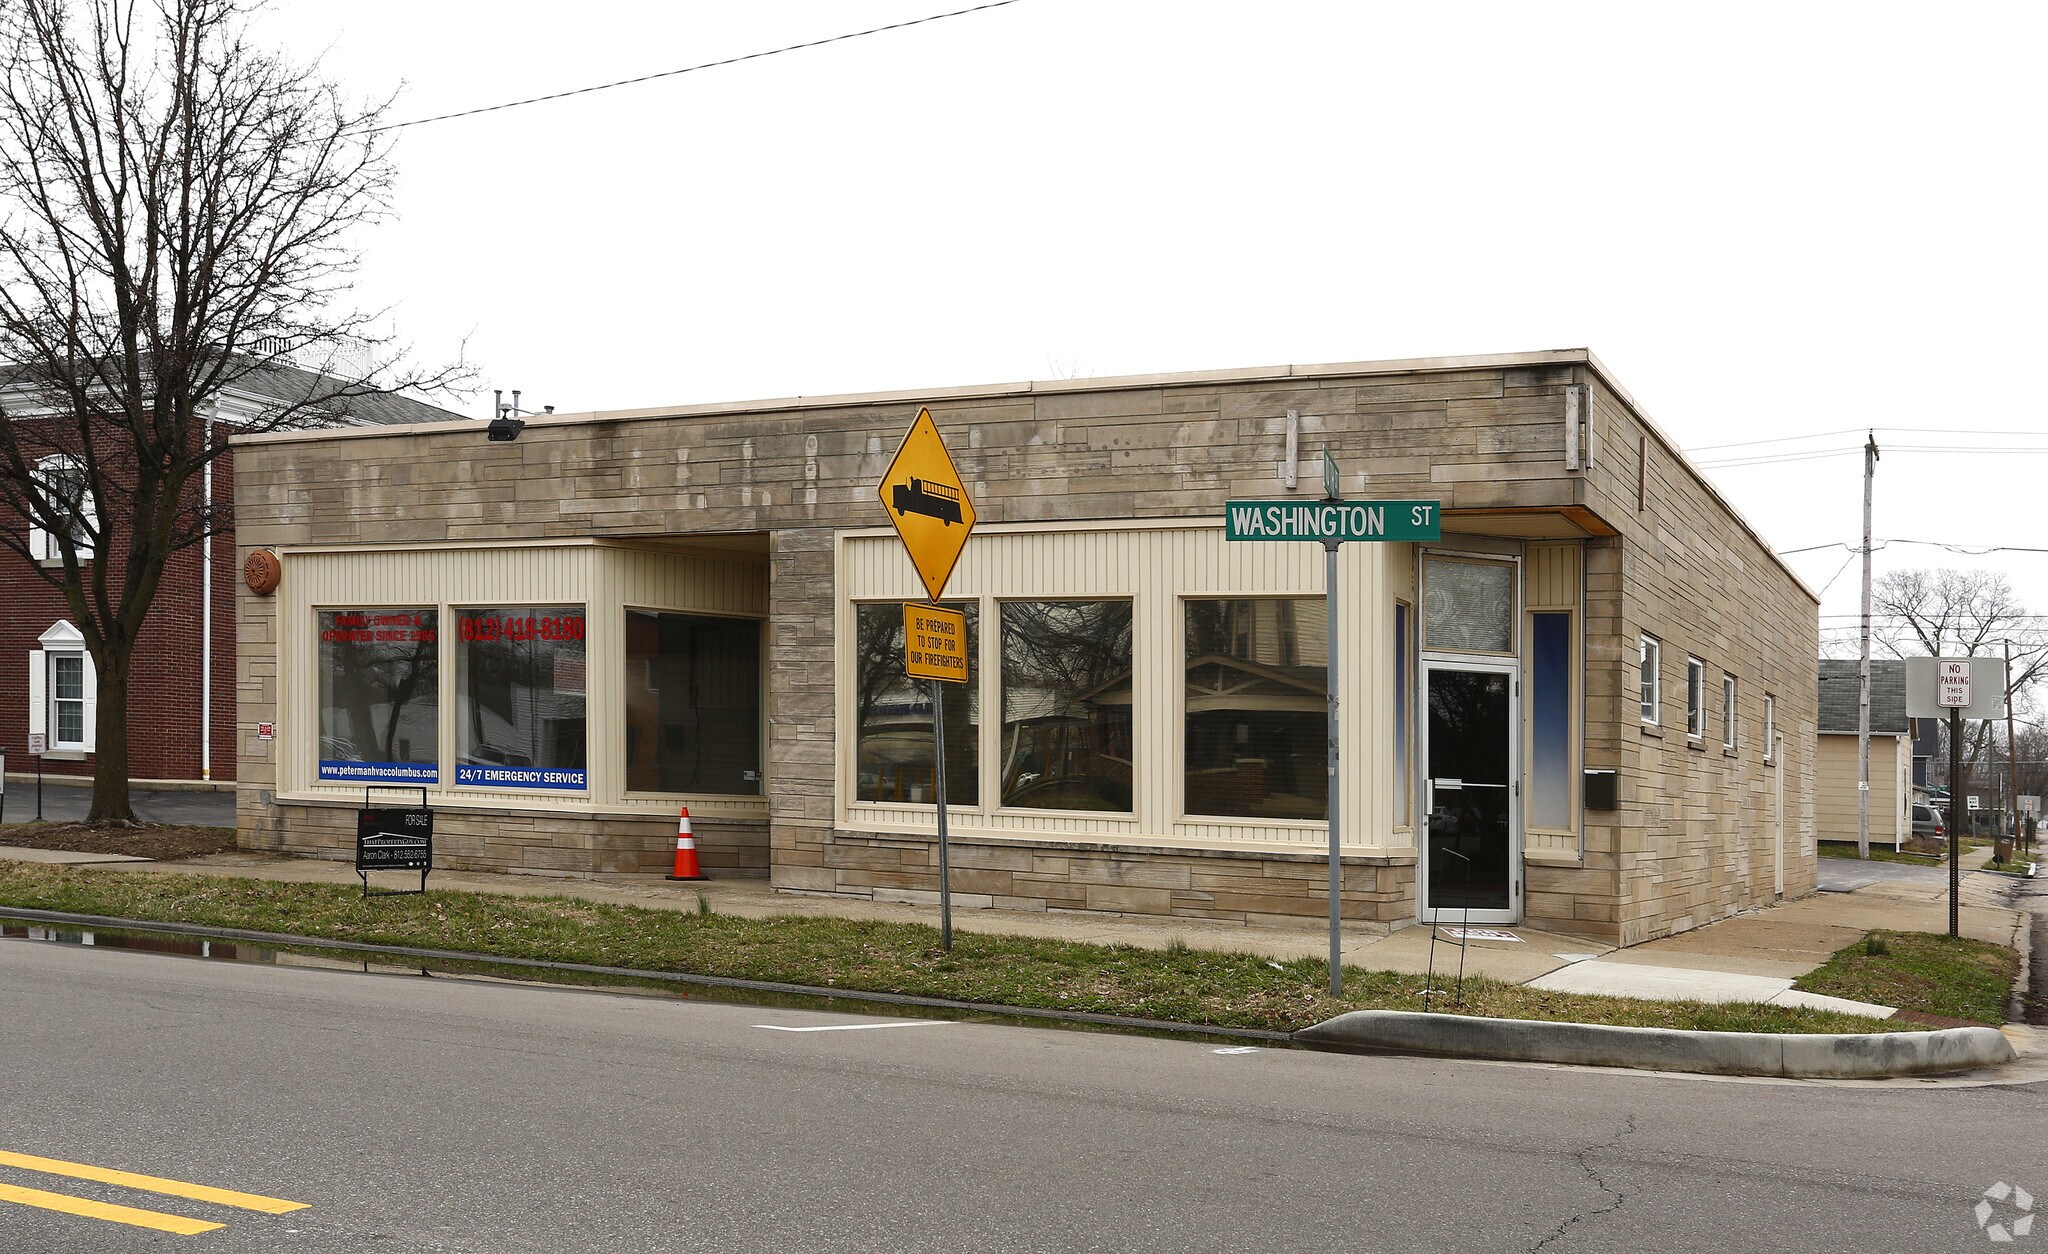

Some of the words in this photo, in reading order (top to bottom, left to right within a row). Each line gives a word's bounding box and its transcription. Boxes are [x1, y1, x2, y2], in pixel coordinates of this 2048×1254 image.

[1231, 506, 1384, 536] WASHINGTON
[1411, 505, 1433, 526] ST
[335, 615, 370, 627] FAMILY
[373, 614, 410, 626] OWNED
[413, 614, 422, 627] &
[916, 618, 924, 631] BE
[926, 619, 955, 635] PREPARED
[322, 630, 373, 642] OPERATED
[375, 630, 405, 642] SINCE
[458, 617, 501, 643] (812)
[503, 616, 585, 641] 418-8180
[917, 635, 925, 648] TO
[928, 637, 942, 650] STOP
[944, 639, 955, 651] FOR
[911, 651, 922, 664] OUR
[925, 653, 964, 669] FIREFIGHTERS
[1949, 664, 1960, 674] NO
[1940, 676, 1969, 685] PARKING
[321, 765, 438, 779] www.petermanhvaccolumbus.com
[460, 769, 482, 782] 24/7
[485, 770, 542, 783] EMERGENCY
[543, 772, 584, 784] SERVICE
[405, 814, 415, 826] FOR
[416, 814, 428, 826] SALE
[363, 850, 377, 860] Aaron
[377, 850, 390, 860] Clark
